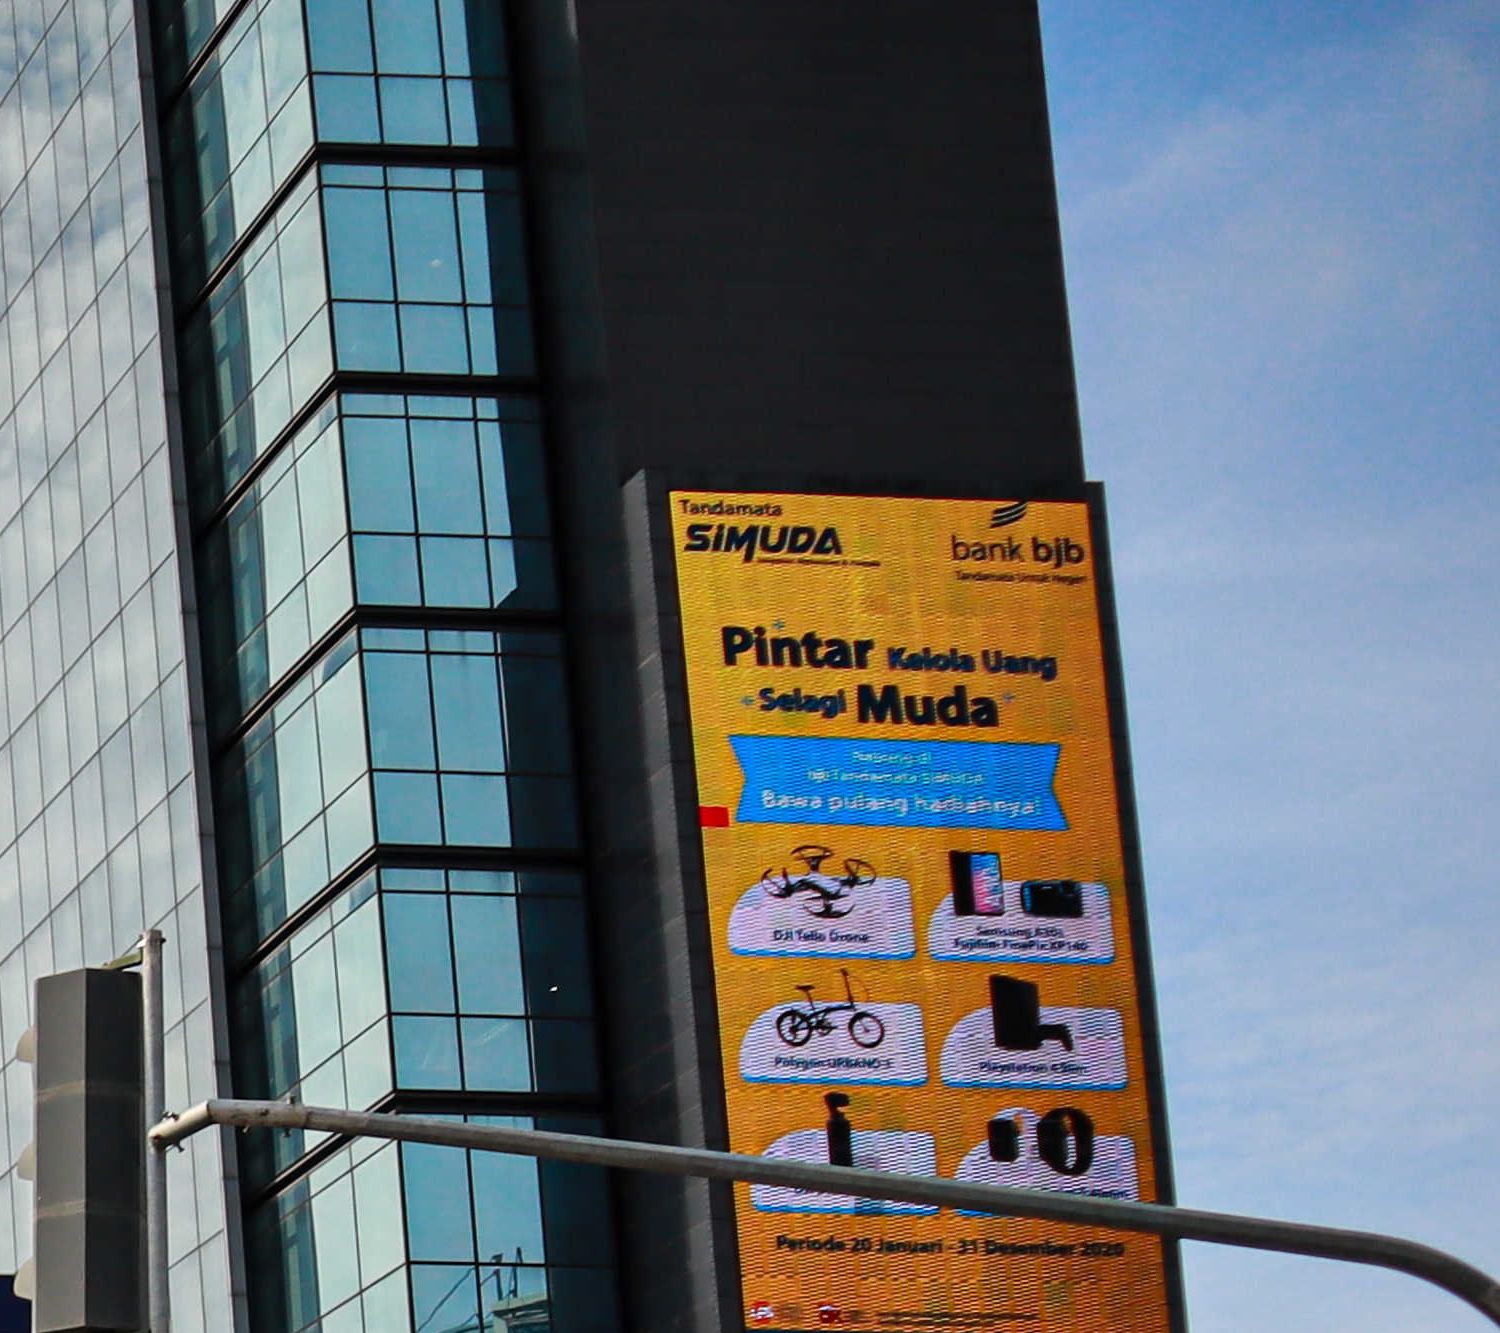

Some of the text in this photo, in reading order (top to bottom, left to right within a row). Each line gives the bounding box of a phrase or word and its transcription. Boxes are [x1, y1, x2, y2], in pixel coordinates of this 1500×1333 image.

[679, 499, 783, 516] Tandamata
[951, 534, 1085, 569] bank bjb
[721, 626, 1058, 682] Pintar Kelola Uang
[759, 684, 999, 727] Selagi Muda
